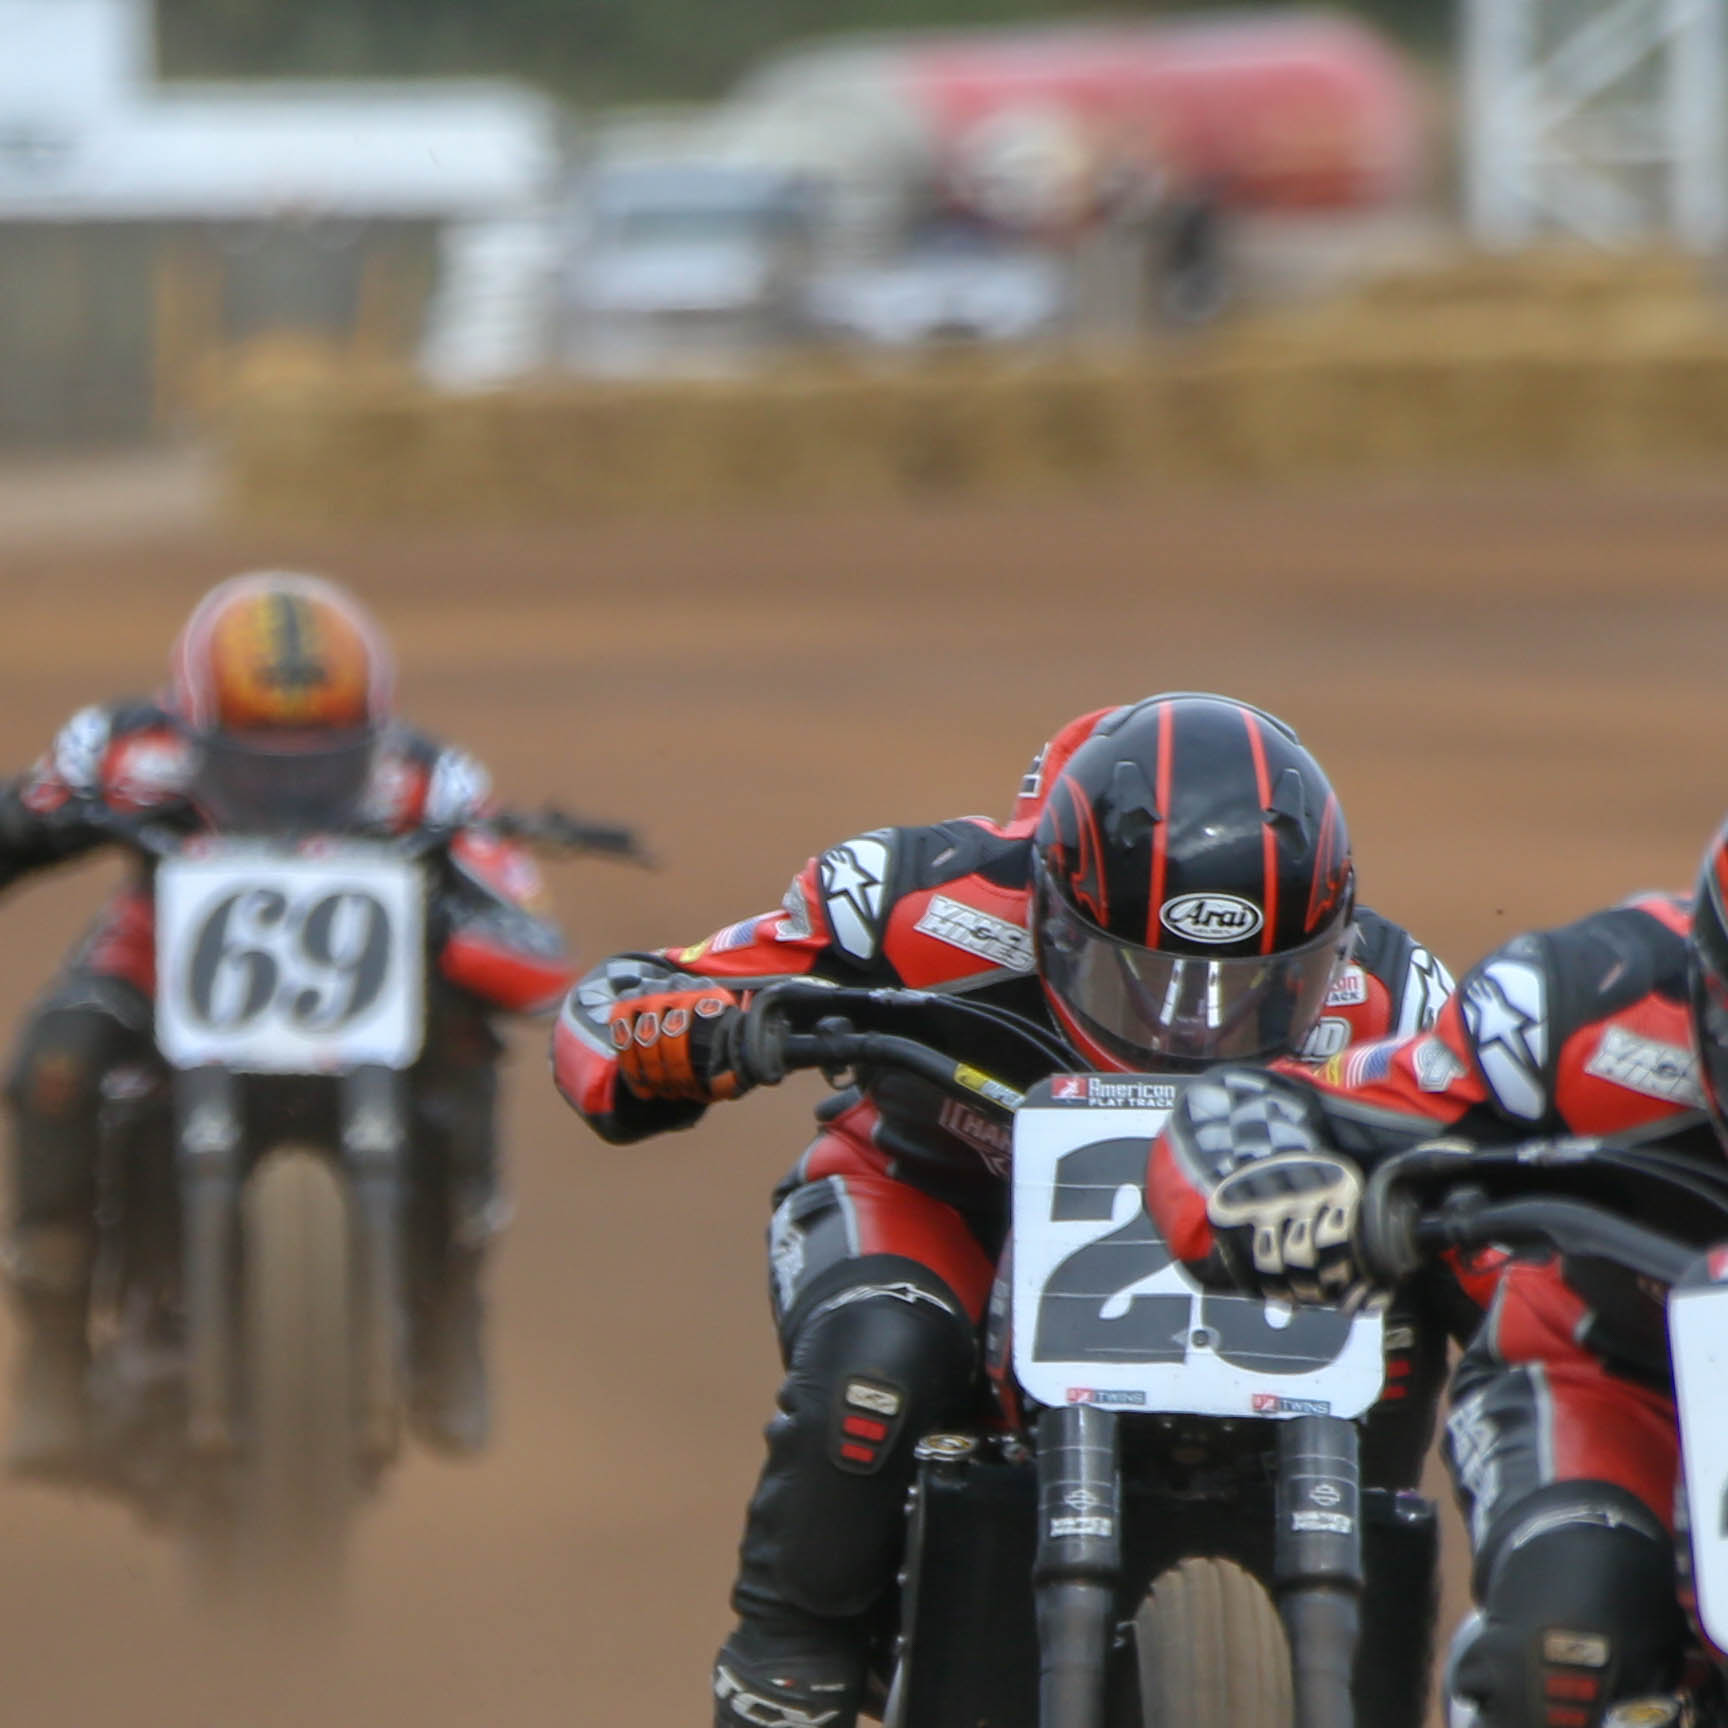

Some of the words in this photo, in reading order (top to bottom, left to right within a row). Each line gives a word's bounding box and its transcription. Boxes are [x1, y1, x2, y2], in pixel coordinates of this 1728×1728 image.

[1169, 901, 1249, 927] Arai
[187, 887, 391, 1034] 69
[1088, 1078, 1176, 1099] American
[1088, 1099, 1123, 1107] FLAT
[1129, 1098, 1174, 1107] TRACK
[1096, 1391, 1143, 1404] TWINS
[1283, 1401, 1329, 1414] TWINS
